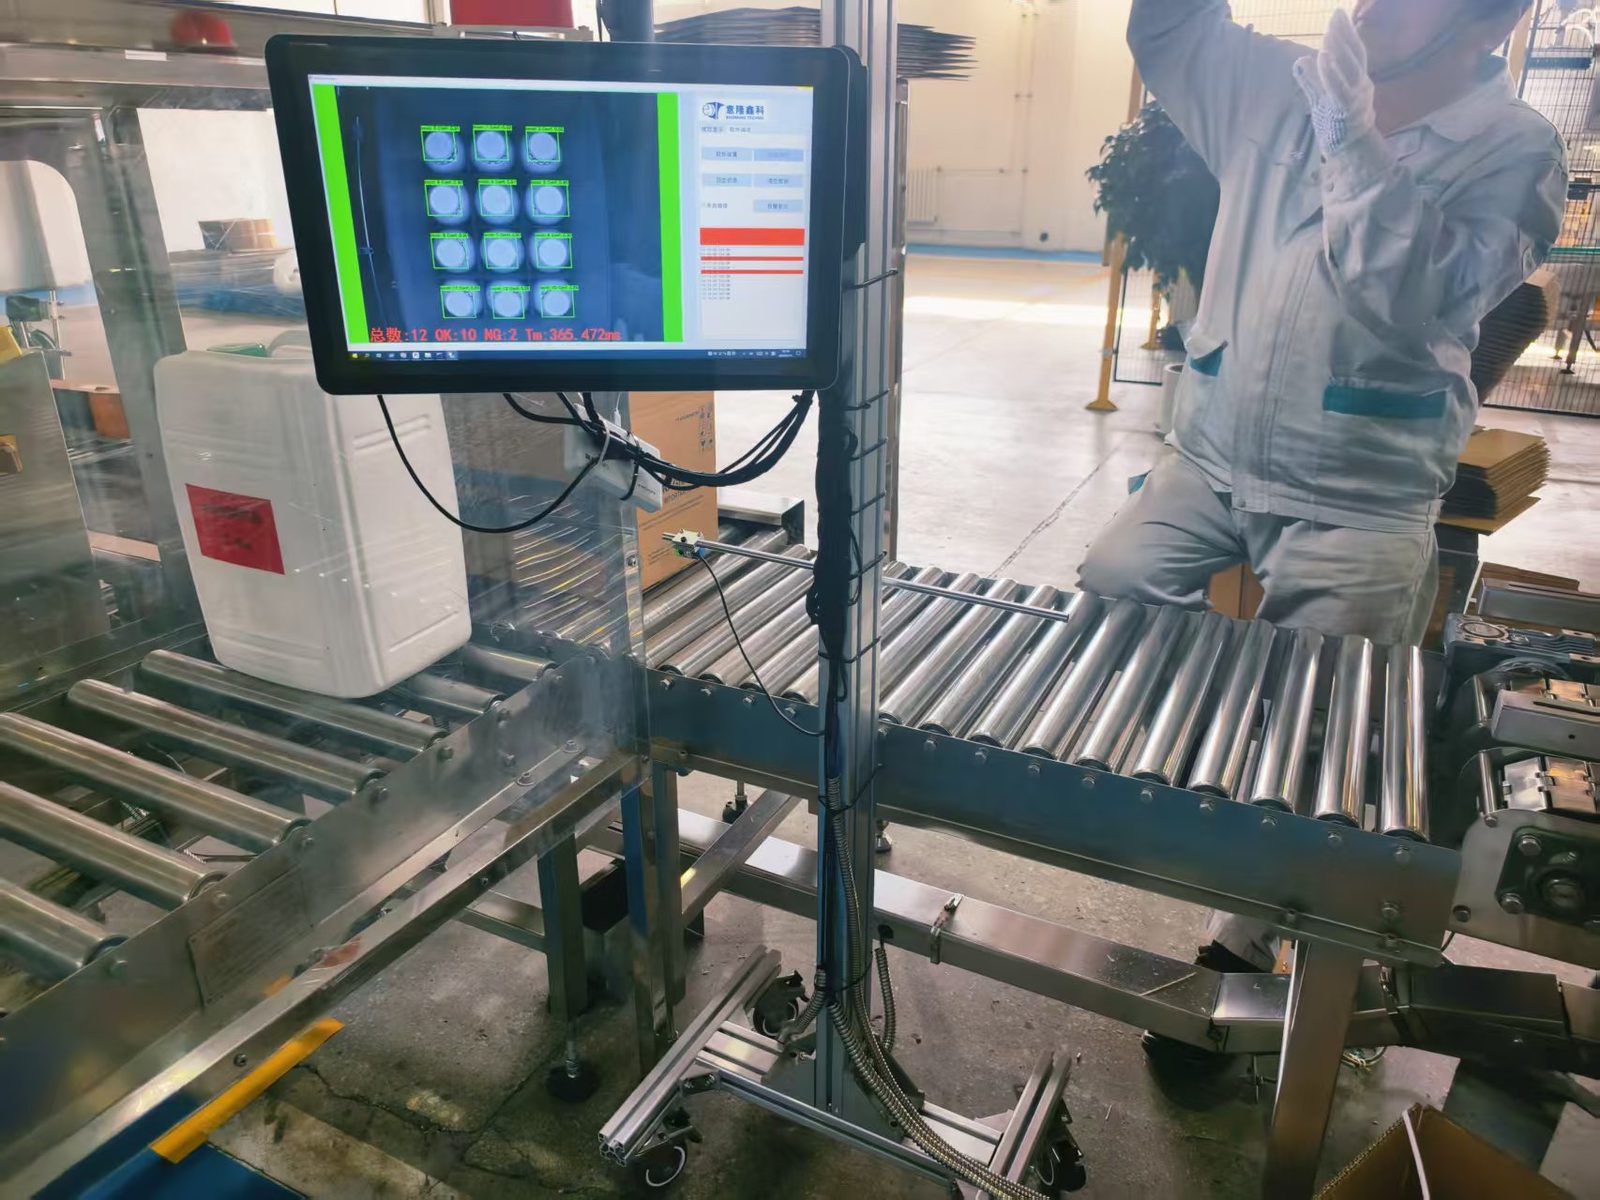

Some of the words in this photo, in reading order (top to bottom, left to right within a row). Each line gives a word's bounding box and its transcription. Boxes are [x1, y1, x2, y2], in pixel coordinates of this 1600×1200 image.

[370, 327, 427, 343] 总数:12
[434, 328, 477, 341] OK:10
[484, 328, 517, 341] NG:2
[525, 327, 621, 342] Tm:365.472ms
